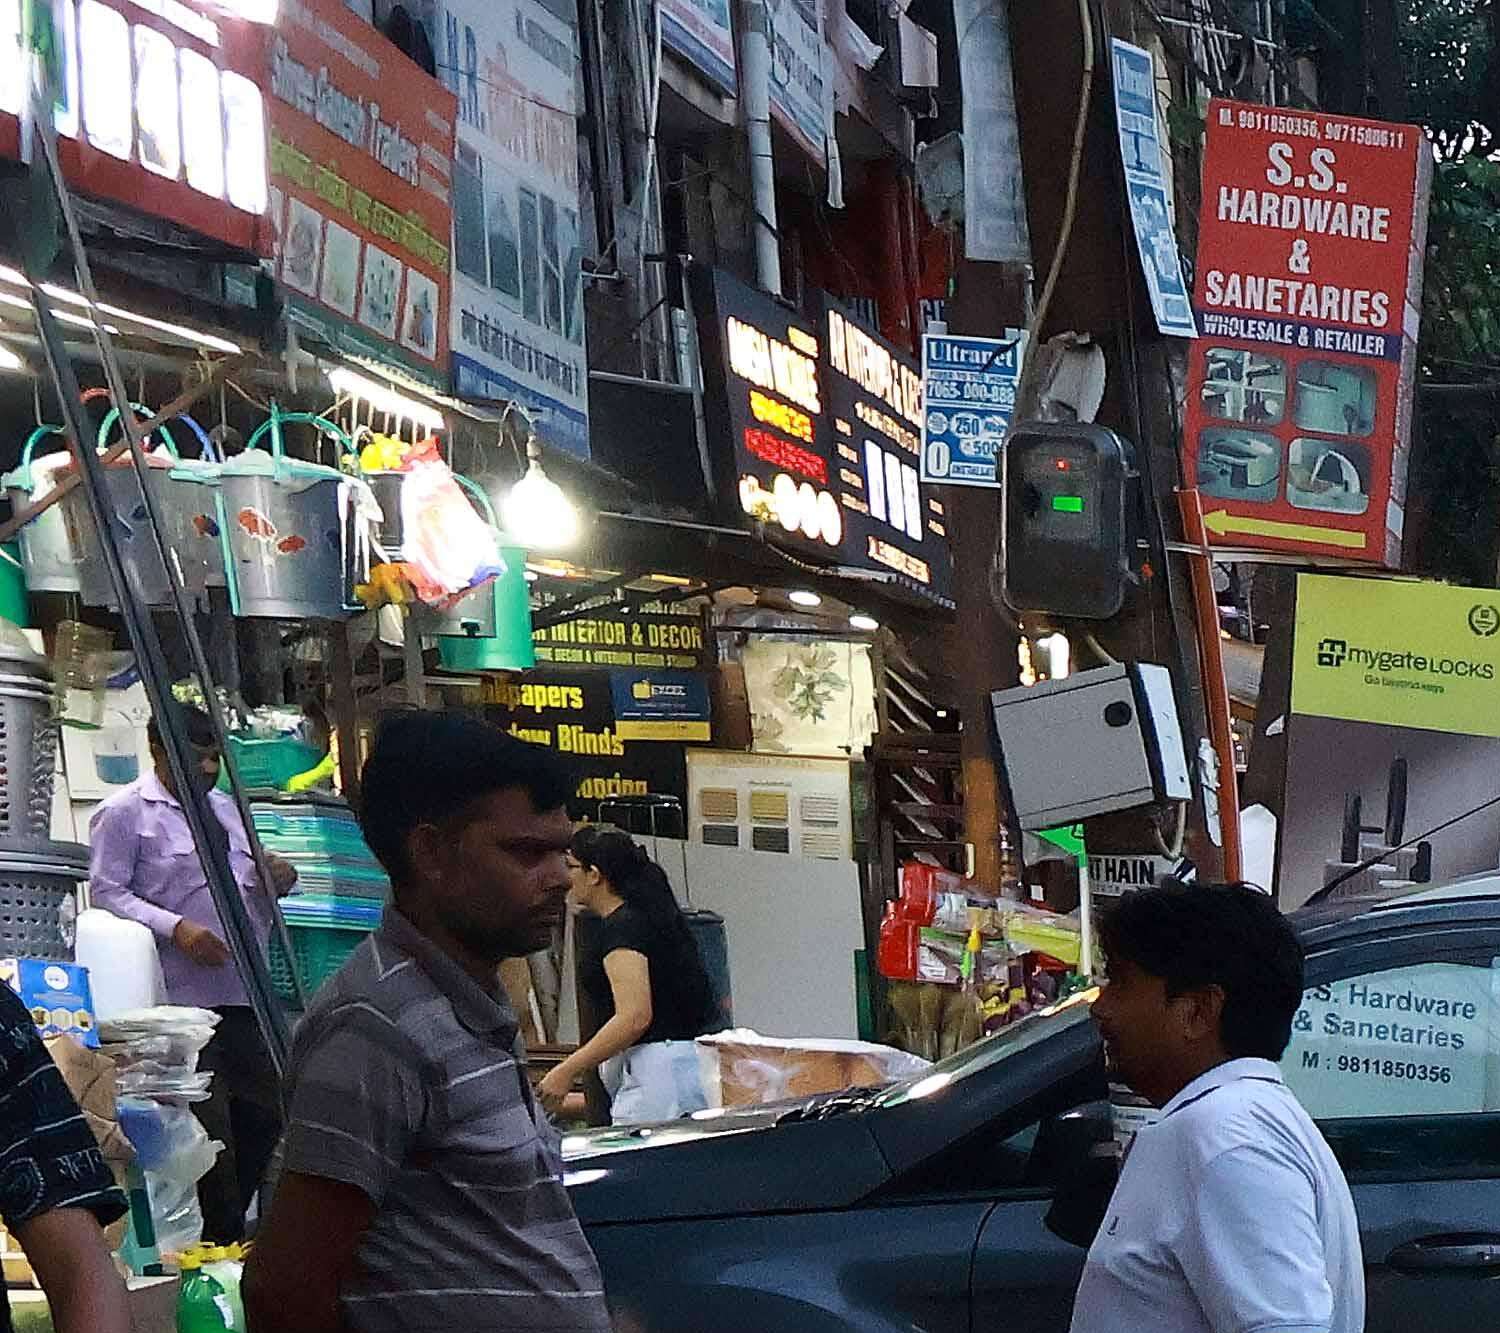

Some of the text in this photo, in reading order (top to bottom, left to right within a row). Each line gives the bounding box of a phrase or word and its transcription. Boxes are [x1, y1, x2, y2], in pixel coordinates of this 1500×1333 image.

[1266, 141, 1348, 194] S.S.
[1217, 185, 1390, 243] HARDWARE
[1288, 239, 1310, 275] &
[1205, 269, 1389, 328] SANETARIES
[1203, 312, 1385, 357] WHOLESALE & RETAILER
[551, 619, 626, 645] INTERIOR
[631, 623, 644, 646] &
[649, 624, 702, 649] DECOR
[557, 723, 625, 756] Blinds
[1105, 857, 1155, 884] HAIN
[1350, 983, 1476, 1020] Hardware
[1294, 1009, 1465, 1050] & Sanetaries
[1302, 1051, 1320, 1069] M
[1337, 1055, 1451, 1084] 9811850356
